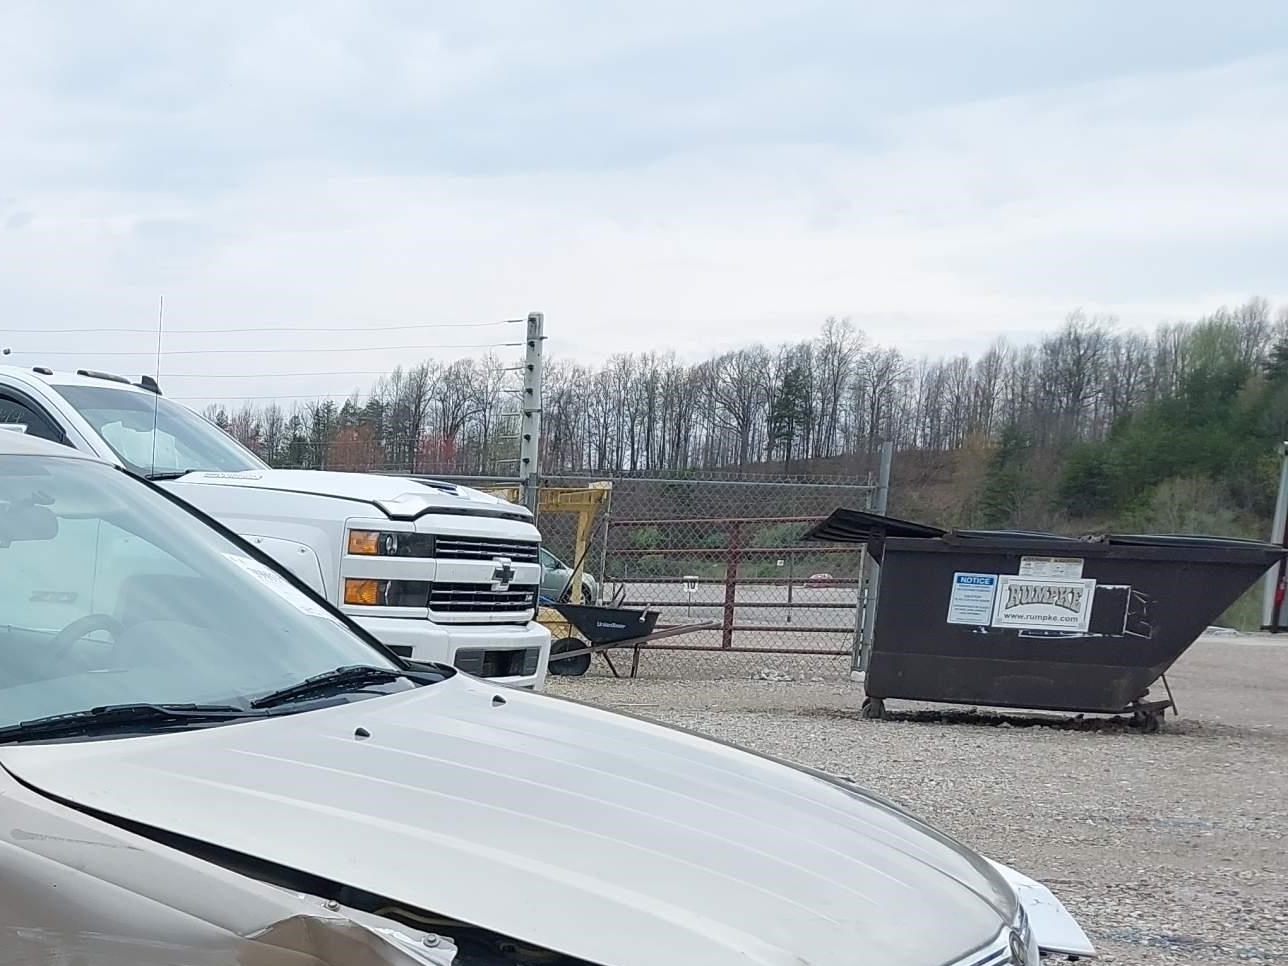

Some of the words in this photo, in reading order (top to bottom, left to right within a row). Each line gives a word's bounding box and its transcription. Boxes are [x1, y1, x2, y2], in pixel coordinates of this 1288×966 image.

[960, 576, 991, 585] NOTICE
[1005, 583, 1084, 614] RUMPKE
[1003, 612, 1079, 623] www.rumpke.com
